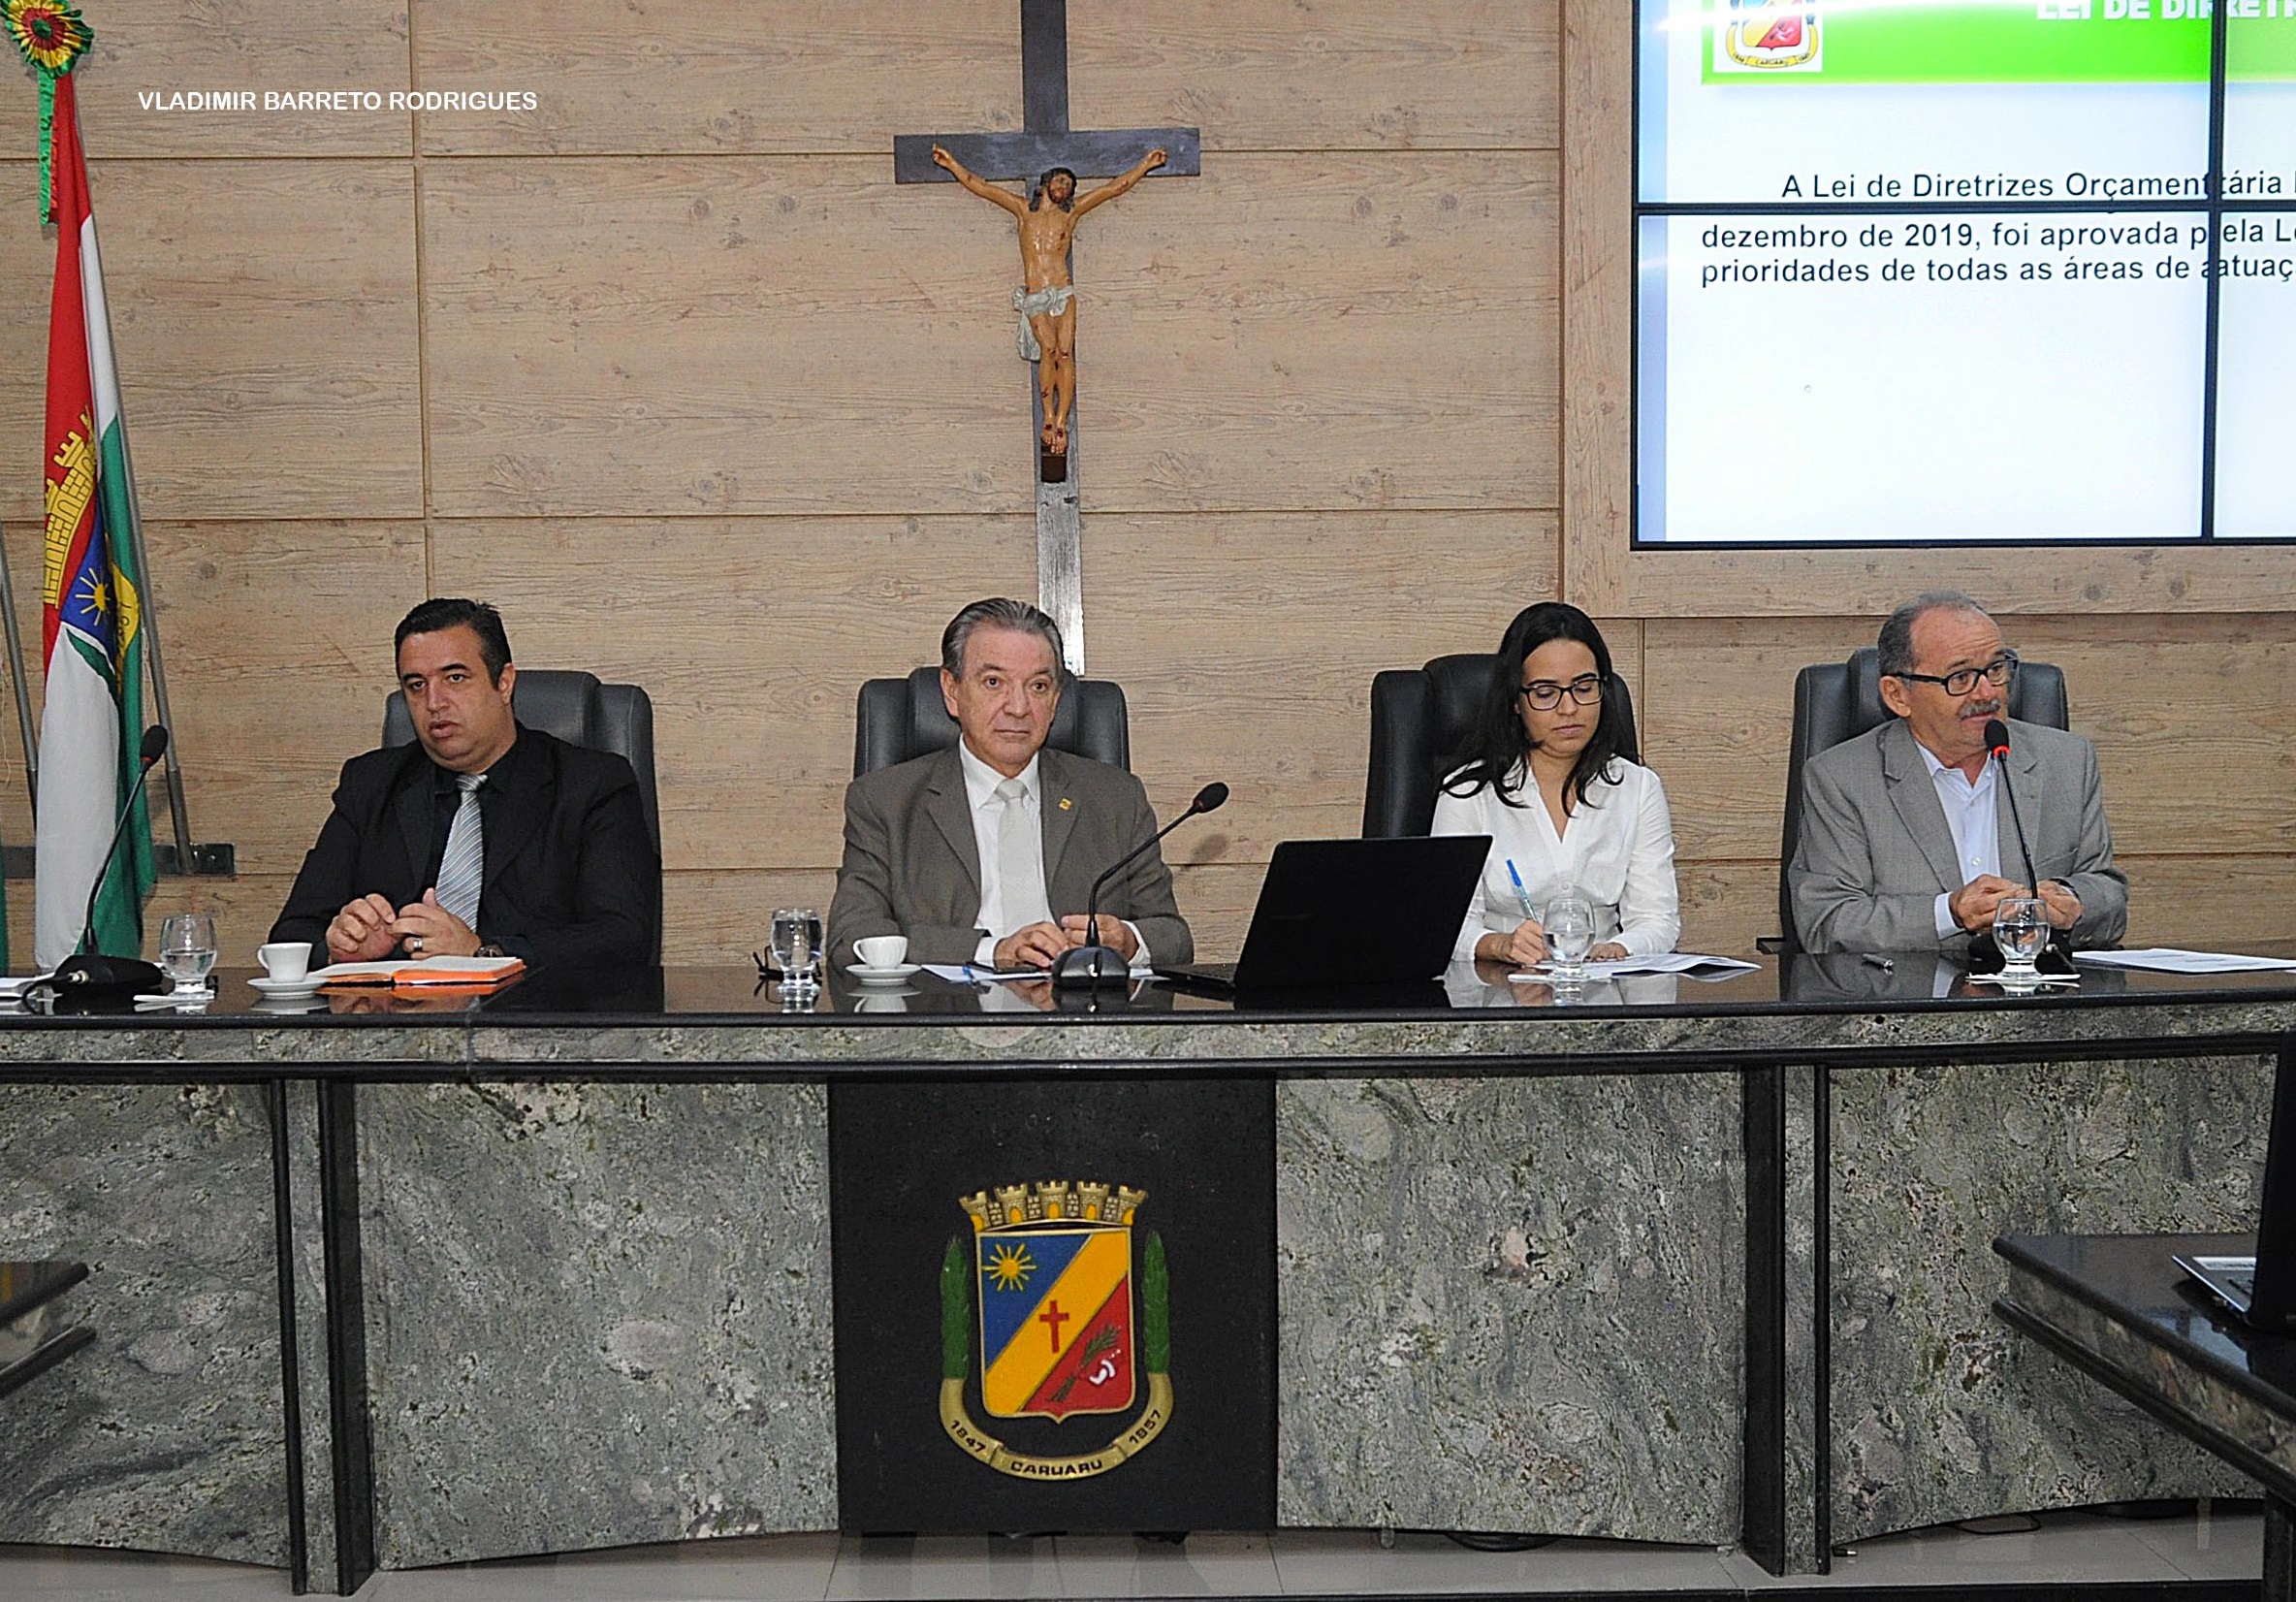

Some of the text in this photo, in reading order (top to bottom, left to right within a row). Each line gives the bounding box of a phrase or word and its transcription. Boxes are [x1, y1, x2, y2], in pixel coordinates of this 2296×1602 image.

[2037, 0, 2091, 19] LEI
[2104, 0, 2151, 18] DE
[1781, 175, 1802, 198] A
[1813, 174, 1855, 198] Lei
[1866, 174, 1901, 198] de
[1913, 173, 2054, 198] Diretrizes
[1702, 224, 1848, 248] dezembro
[1859, 223, 1894, 247] de
[1904, 223, 1980, 251] 2019,
[1992, 222, 2028, 246] foi
[2040, 220, 2178, 252] aprovada
[1702, 258, 1869, 289] prioridades
[1881, 258, 1916, 282] de
[1927, 257, 2008, 281] todas
[2020, 262, 2053, 280] as
[2063, 255, 2144, 280] áreas
[2155, 255, 2189, 279] de
[1010, 1459, 1103, 1475] CARUARU
